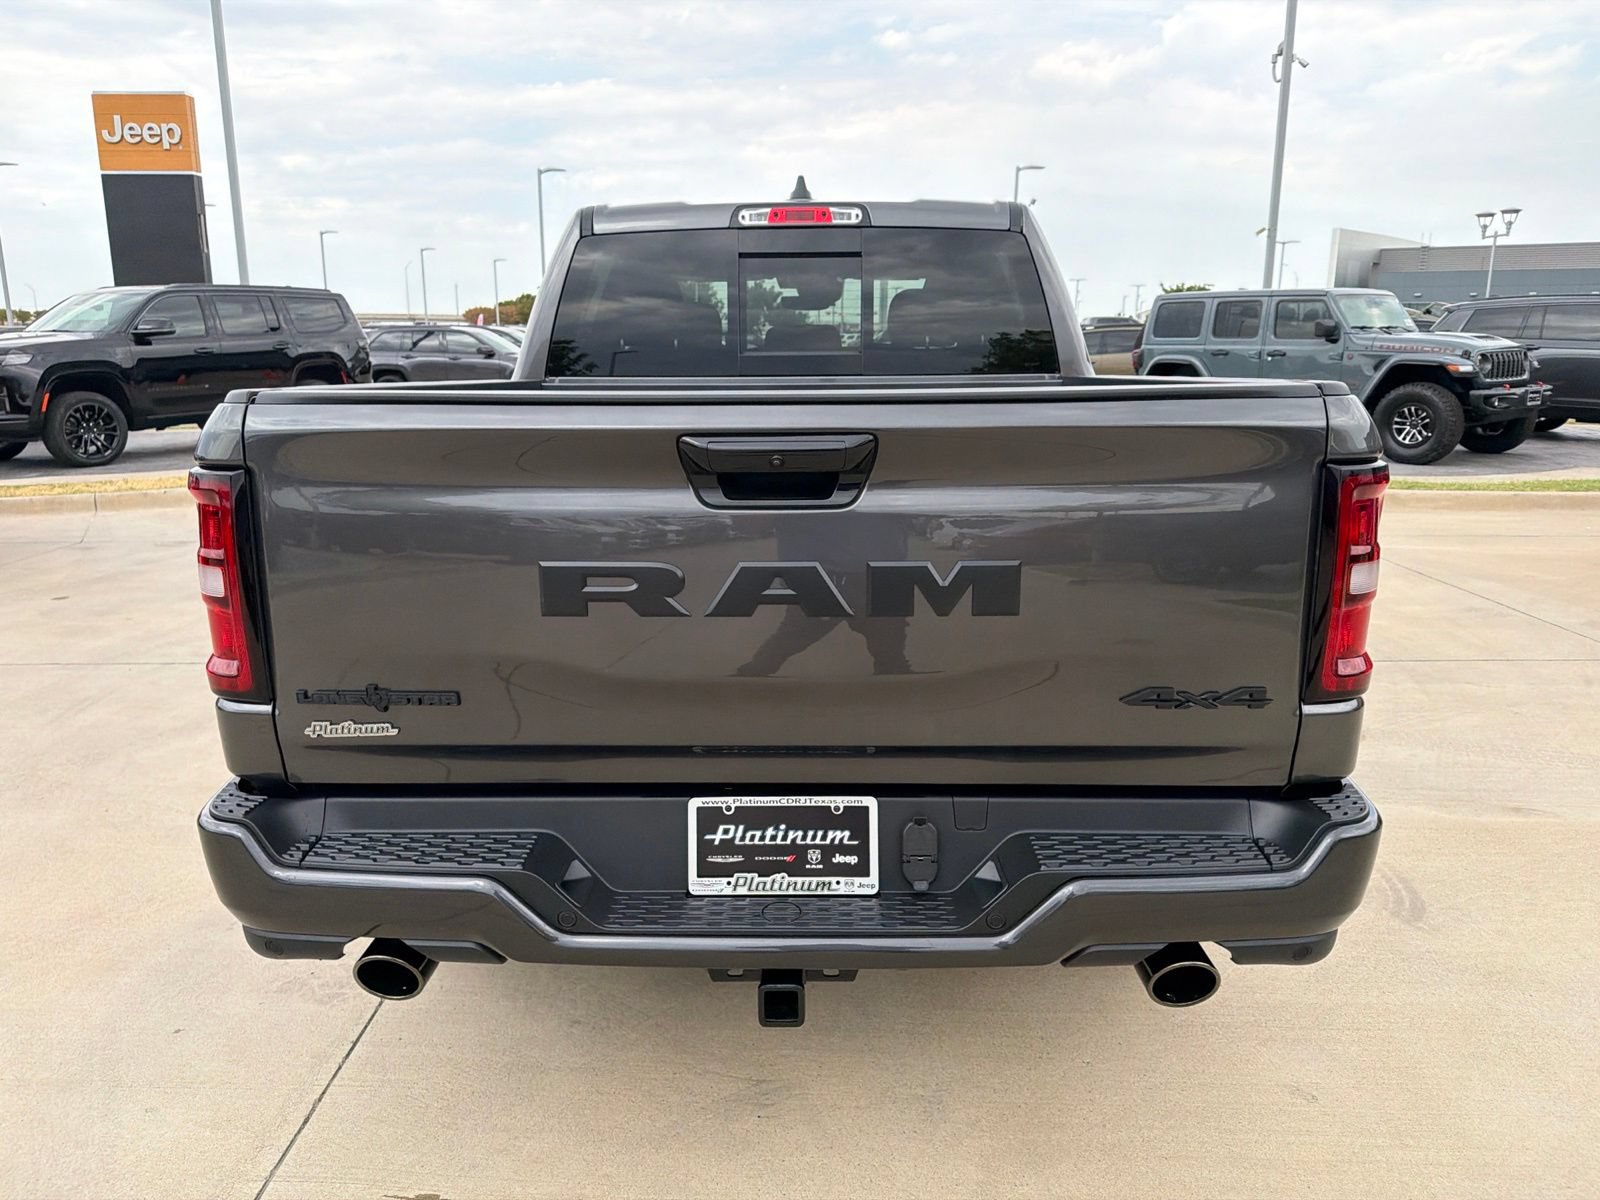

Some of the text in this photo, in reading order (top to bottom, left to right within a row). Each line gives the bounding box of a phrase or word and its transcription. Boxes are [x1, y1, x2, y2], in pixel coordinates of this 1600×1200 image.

[101, 114, 181, 150] Jeep
[538, 560, 1021, 617] RAM
[305, 722, 399, 738] Platinum
[701, 797, 863, 805] www.PlatinumCDRJTexas.com
[704, 824, 859, 845] Platinum
[832, 853, 858, 865] Jeep
[732, 876, 840, 892] Platinum
